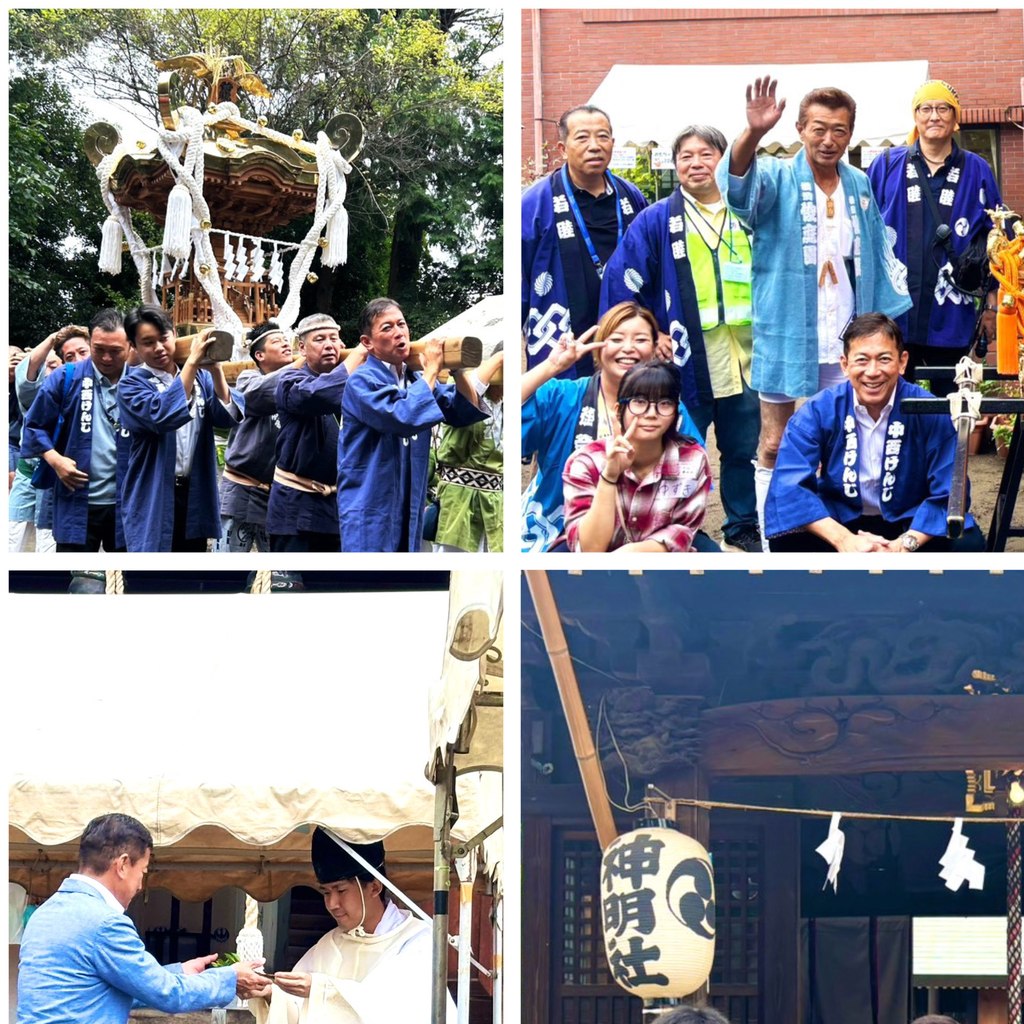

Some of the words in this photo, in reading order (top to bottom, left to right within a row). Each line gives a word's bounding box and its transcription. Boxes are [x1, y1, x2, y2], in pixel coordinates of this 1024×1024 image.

[843, 415, 858, 498] 中西けんじ
[881, 421, 905, 502] 中西けんじ
[602, 834, 669, 989] 神明社
